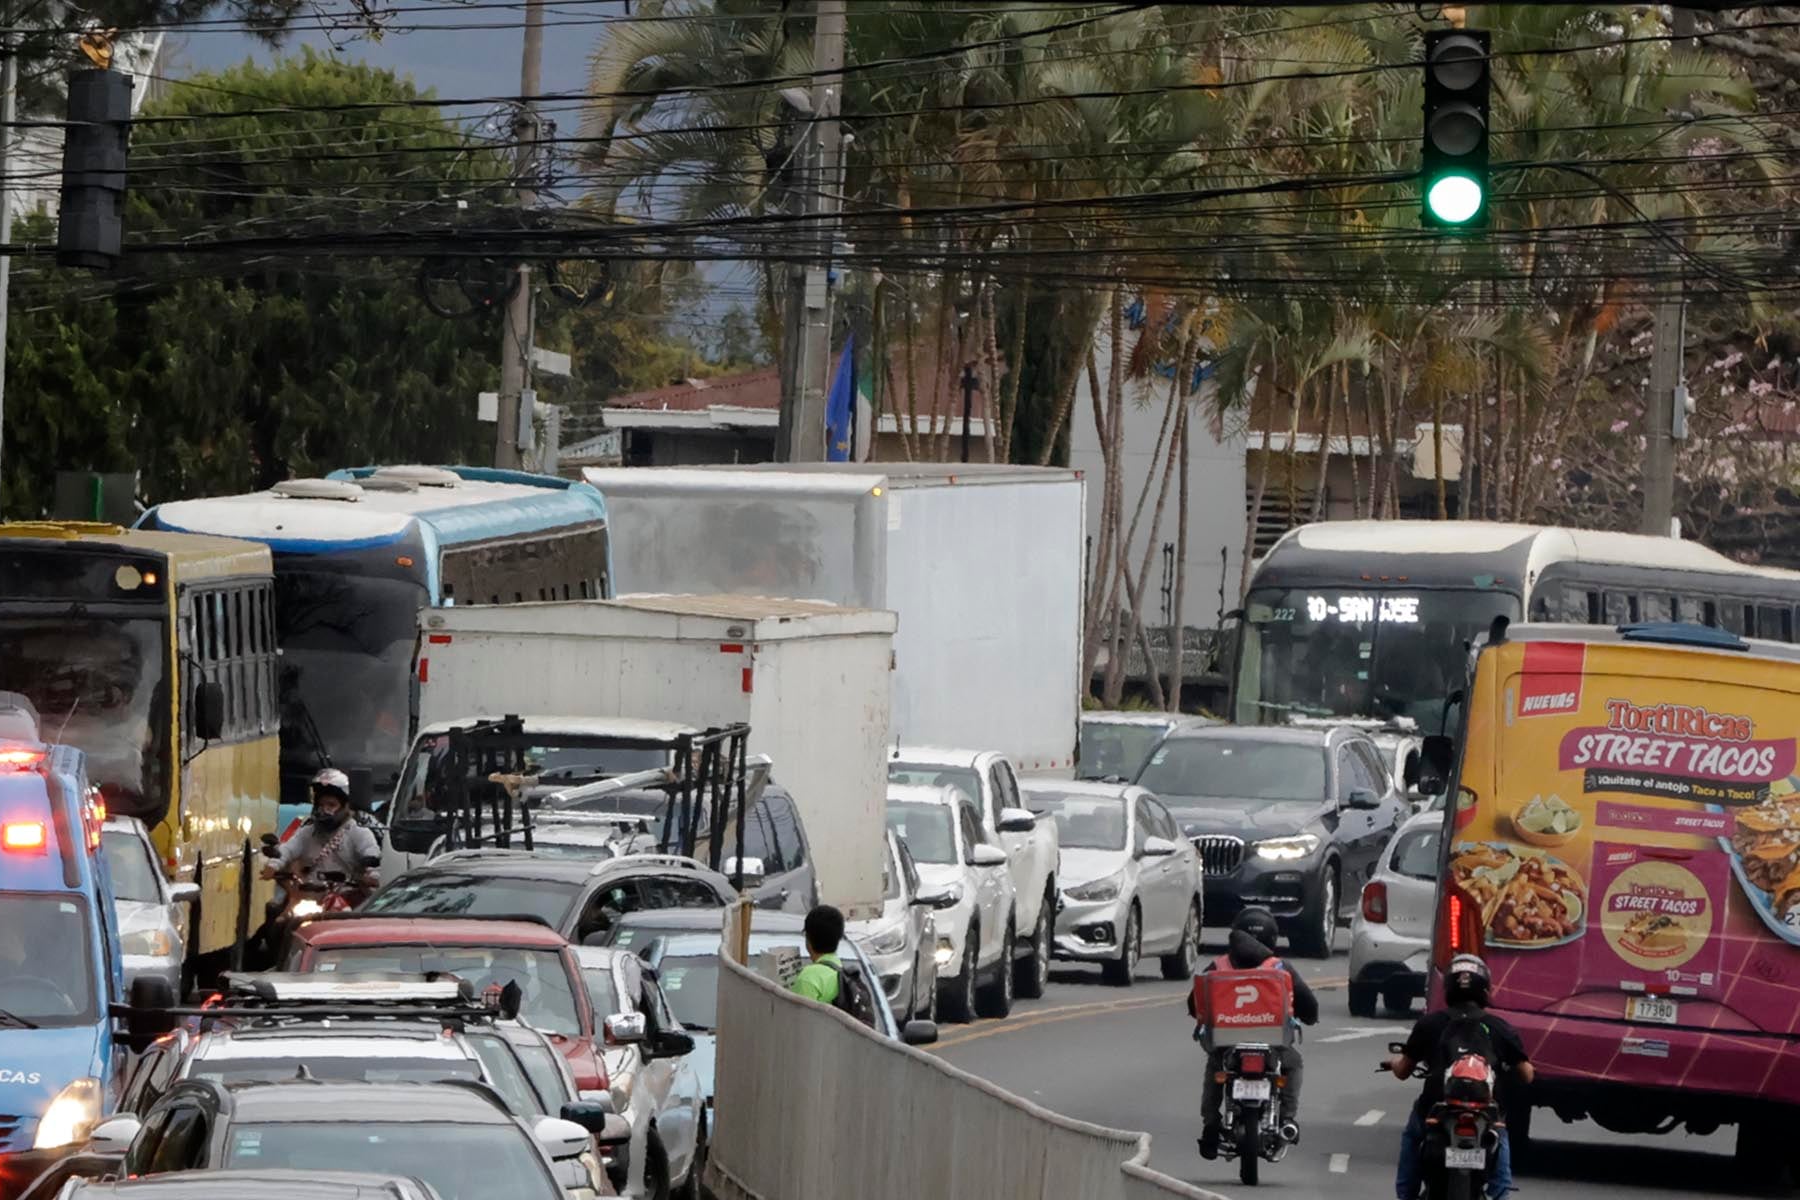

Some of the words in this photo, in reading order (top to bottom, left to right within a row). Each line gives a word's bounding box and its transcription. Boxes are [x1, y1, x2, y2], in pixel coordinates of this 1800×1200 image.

[1274, 608, 1296, 621] 222
[1523, 692, 1576, 712] NUEVAS
[1607, 700, 1752, 742] TortiRicas
[1573, 734, 1685, 768] STREET
[1688, 743, 1776, 777] TACOS
[1643, 780, 1654, 789] el
[1655, 784, 1690, 794] antojo
[1692, 785, 1716, 797] Taco
[1727, 789, 1756, 800] Taco!
[1615, 895, 1659, 910] STREET
[1660, 899, 1698, 914] TACOS
[1665, 968, 1680, 982] 10
[1217, 1012, 1275, 1024] PedidosYa
